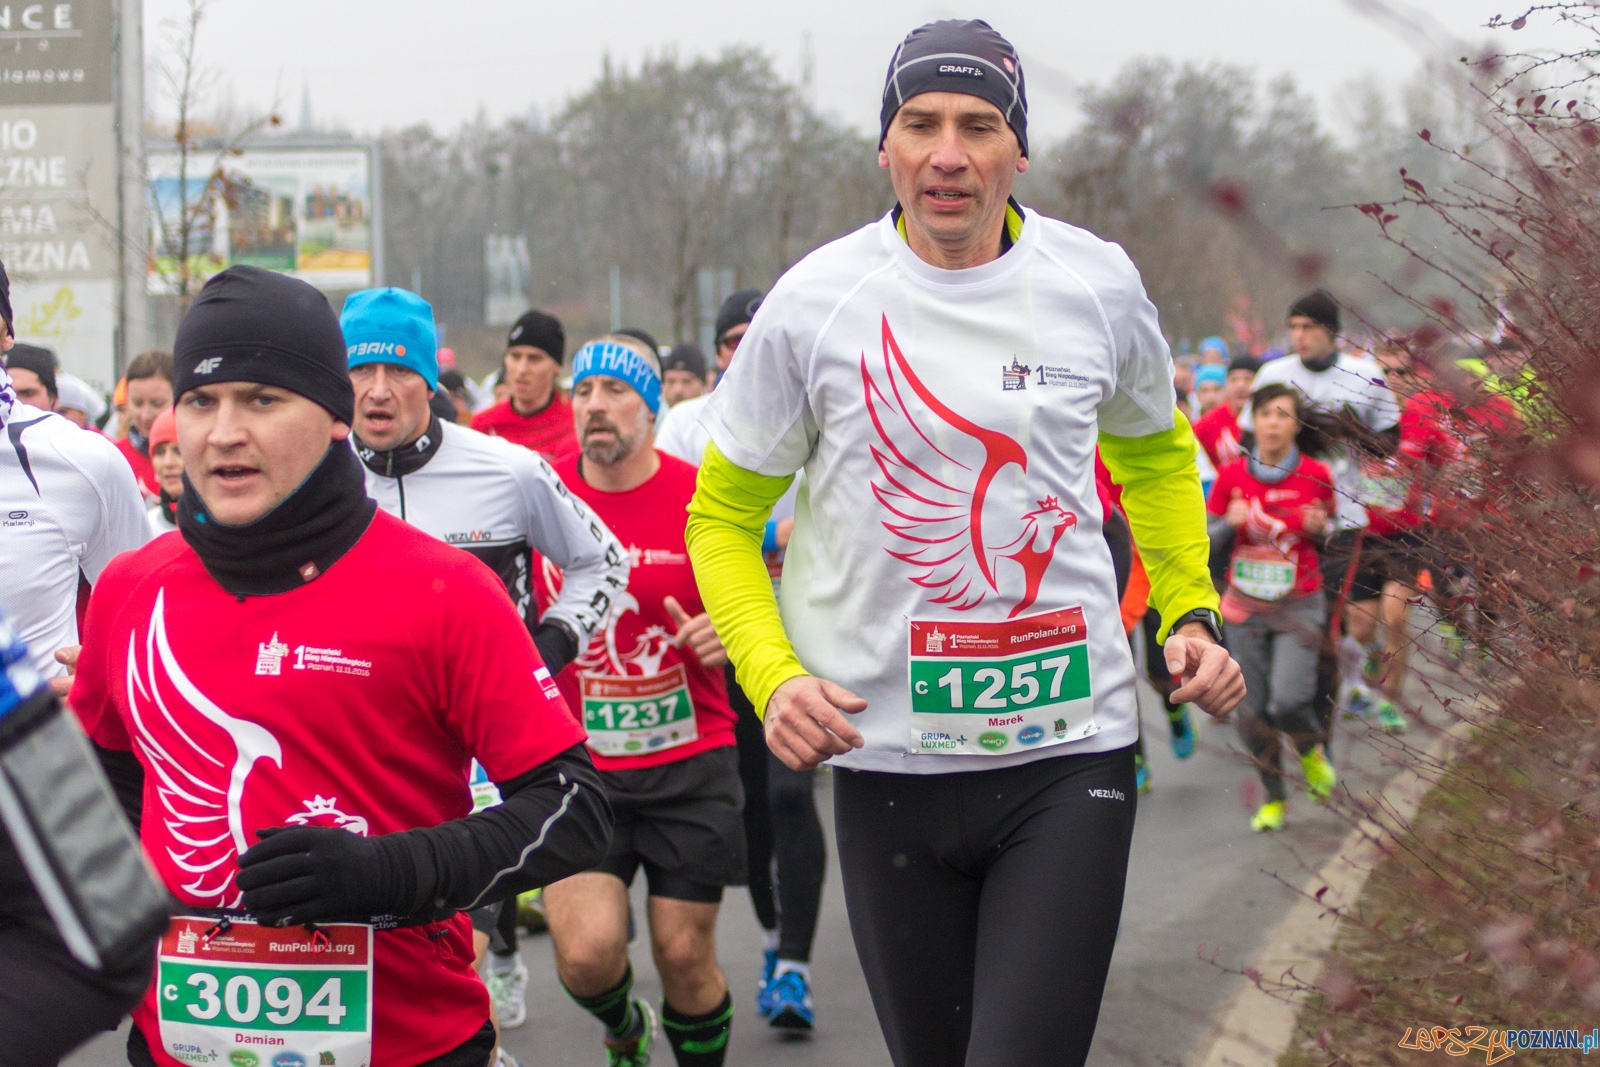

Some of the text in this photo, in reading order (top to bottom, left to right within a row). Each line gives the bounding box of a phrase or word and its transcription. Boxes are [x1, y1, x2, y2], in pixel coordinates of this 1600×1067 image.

[939, 65, 974, 74] CRAFT
[0, 156, 66, 187] ZNE
[601, 344, 654, 392] HAPPY
[1036, 365, 1047, 385] 1
[949, 634, 958, 649] 1
[1010, 624, 1077, 644] RunPoland.org
[293, 644, 306, 670] 1
[915, 654, 1071, 709] C 1257
[597, 695, 679, 729] 1237
[988, 714, 1024, 727] Marek
[921, 733, 951, 741] GRUPA
[921, 740, 957, 749] LUXMED
[269, 942, 355, 955] RunPoland.org
[163, 972, 347, 1026] C 3094
[235, 1033, 285, 1046] Damian
[172, 1043, 202, 1054] GRUPA
[174, 1051, 209, 1063] LUXMED
